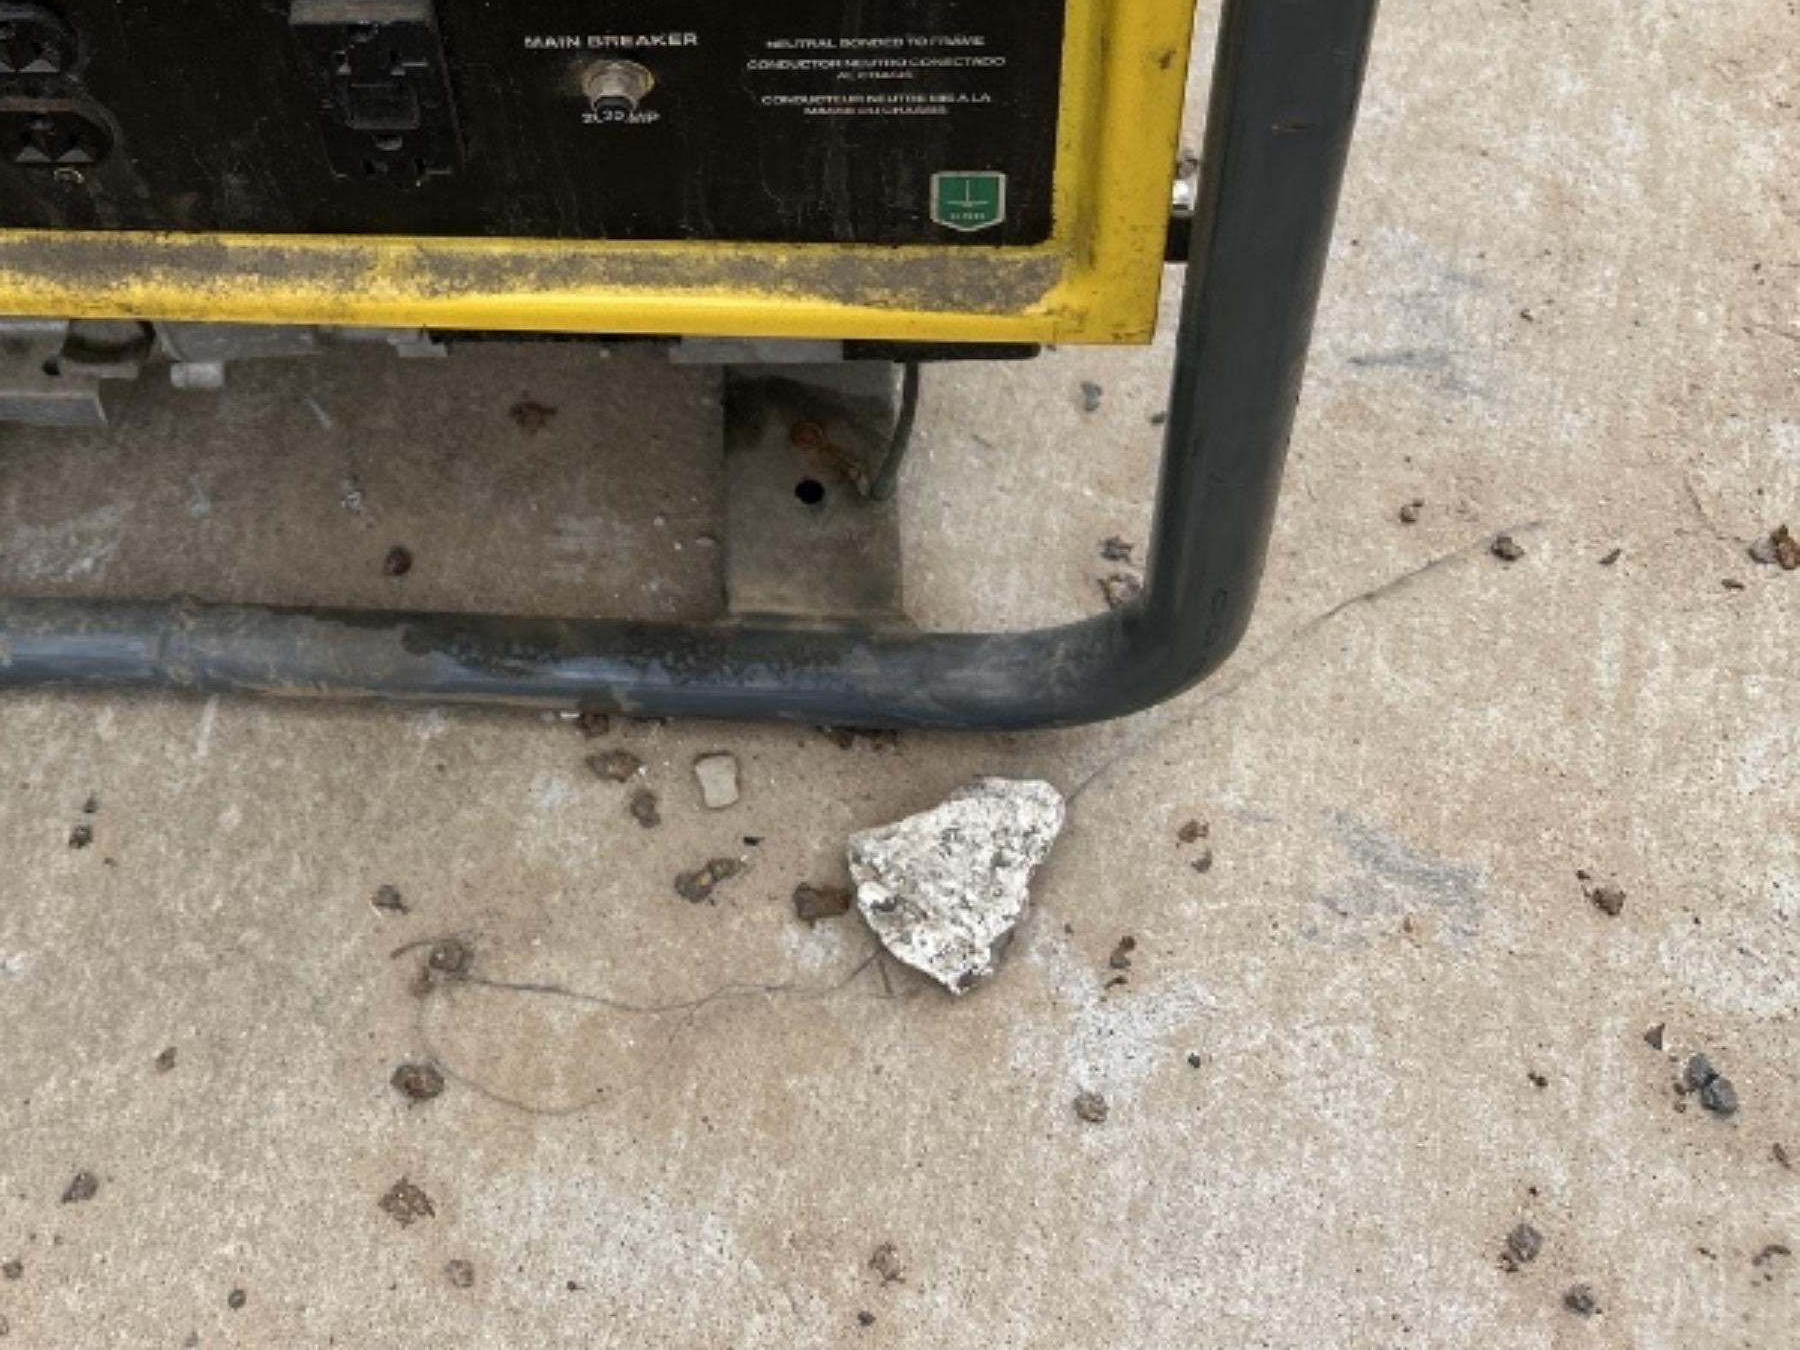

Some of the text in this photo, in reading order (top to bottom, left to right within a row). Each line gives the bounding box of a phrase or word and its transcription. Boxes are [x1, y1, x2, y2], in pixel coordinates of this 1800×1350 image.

[524, 32, 699, 49] MAIN BREAKER
[765, 39, 837, 50] NEUTRAL
